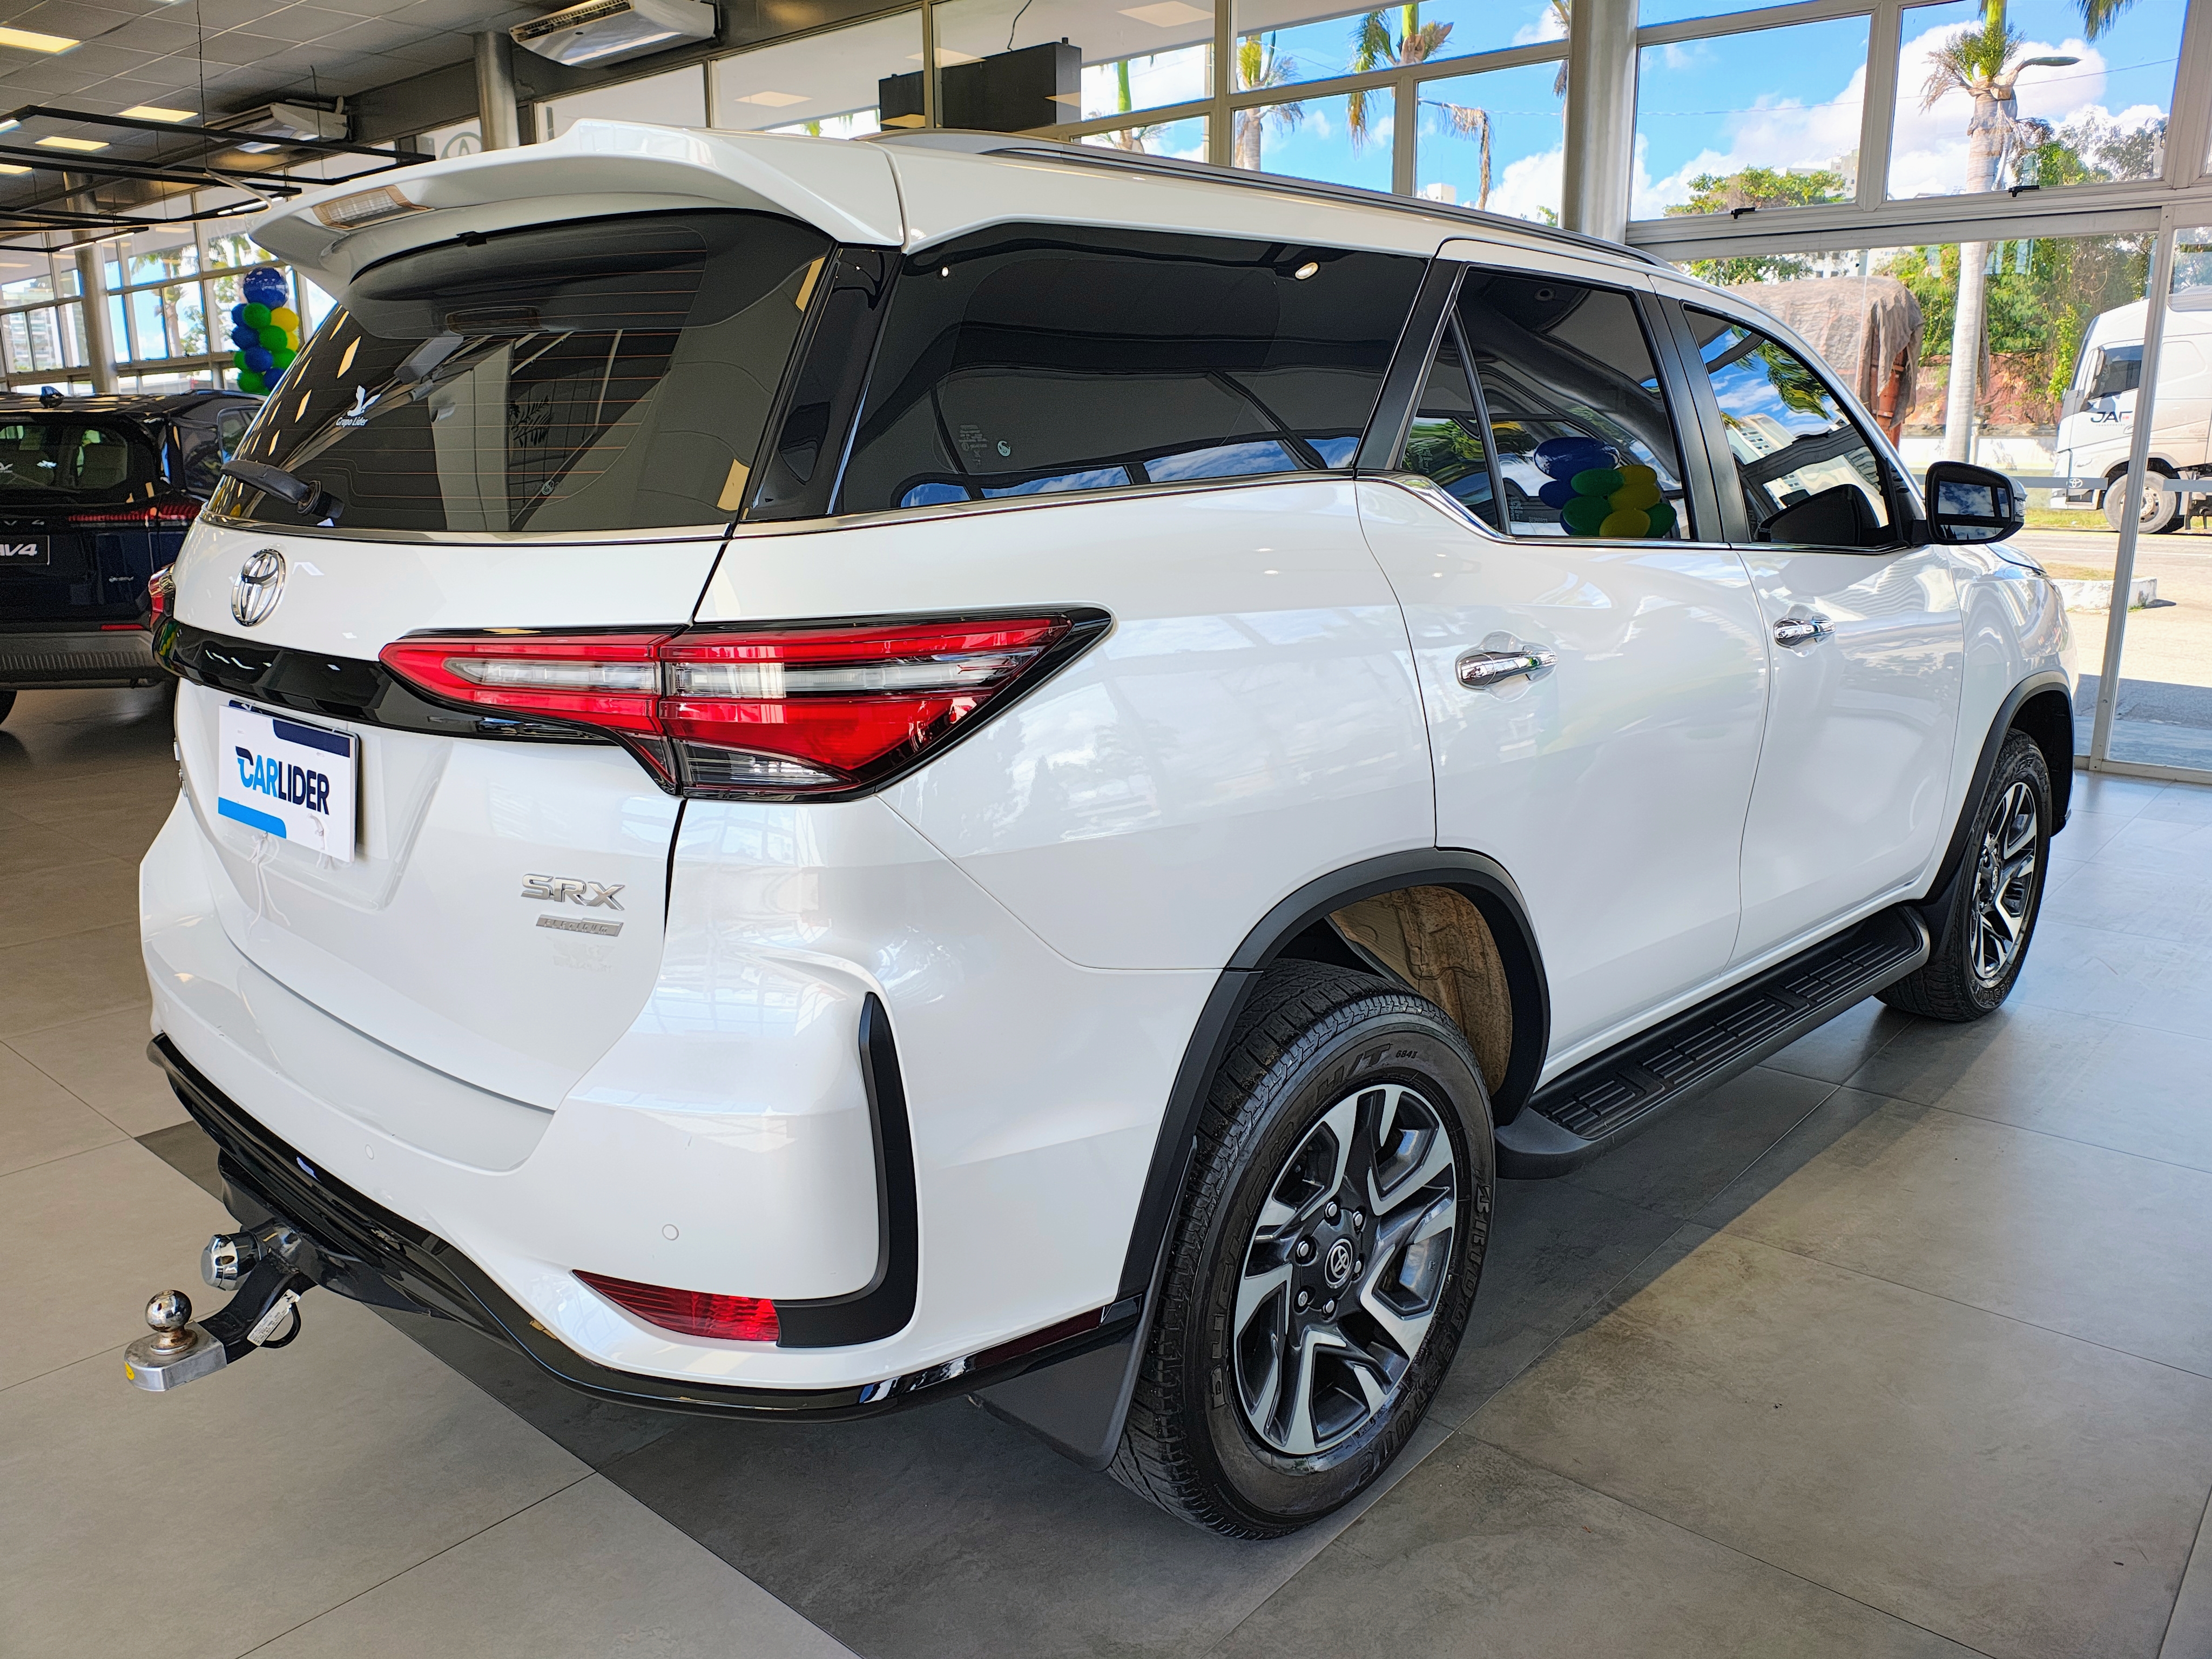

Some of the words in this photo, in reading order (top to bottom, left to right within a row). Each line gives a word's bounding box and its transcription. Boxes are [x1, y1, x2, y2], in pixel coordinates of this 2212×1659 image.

[336, 417, 353, 428] Grupo
[235, 746, 330, 815] CARLIDER
[521, 873, 625, 911] SRX
